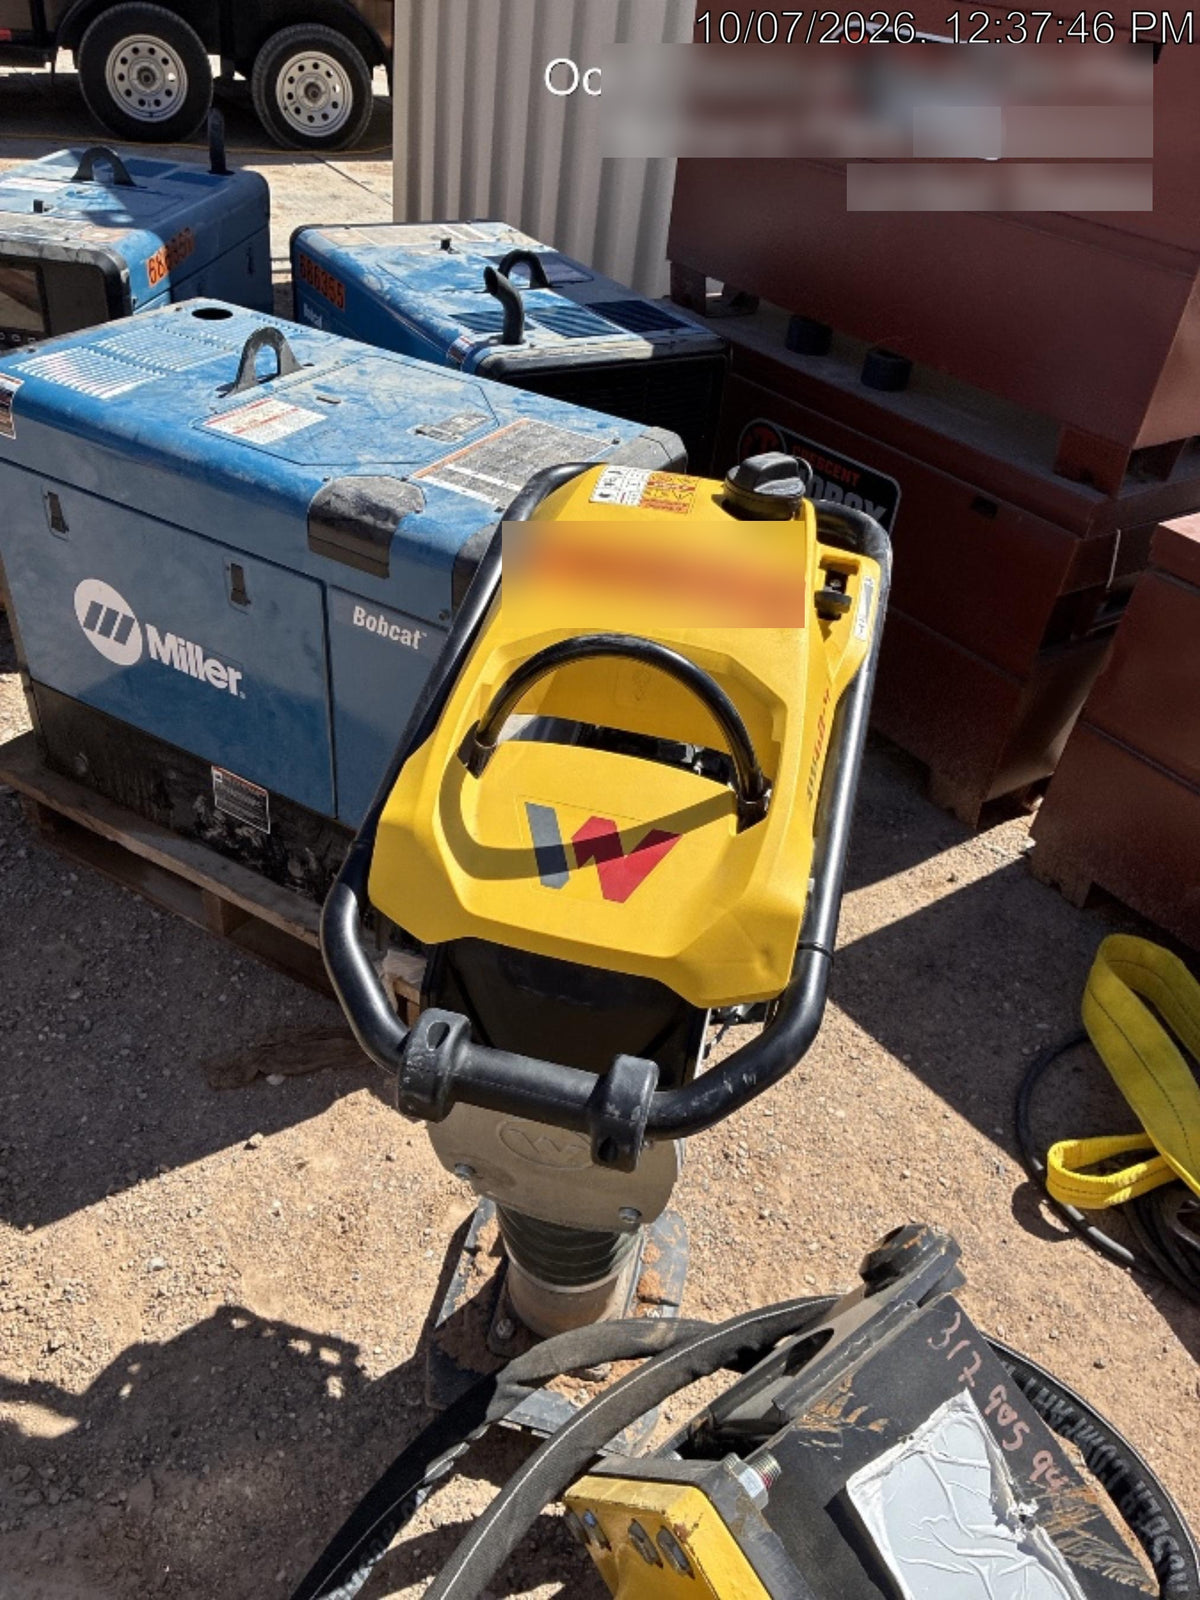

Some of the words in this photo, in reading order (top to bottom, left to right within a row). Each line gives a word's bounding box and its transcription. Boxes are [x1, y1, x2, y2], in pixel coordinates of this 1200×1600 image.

[145, 623, 243, 697] Miller
[352, 605, 422, 650] Bobcat
[927, 1312, 982, 1388] 317
